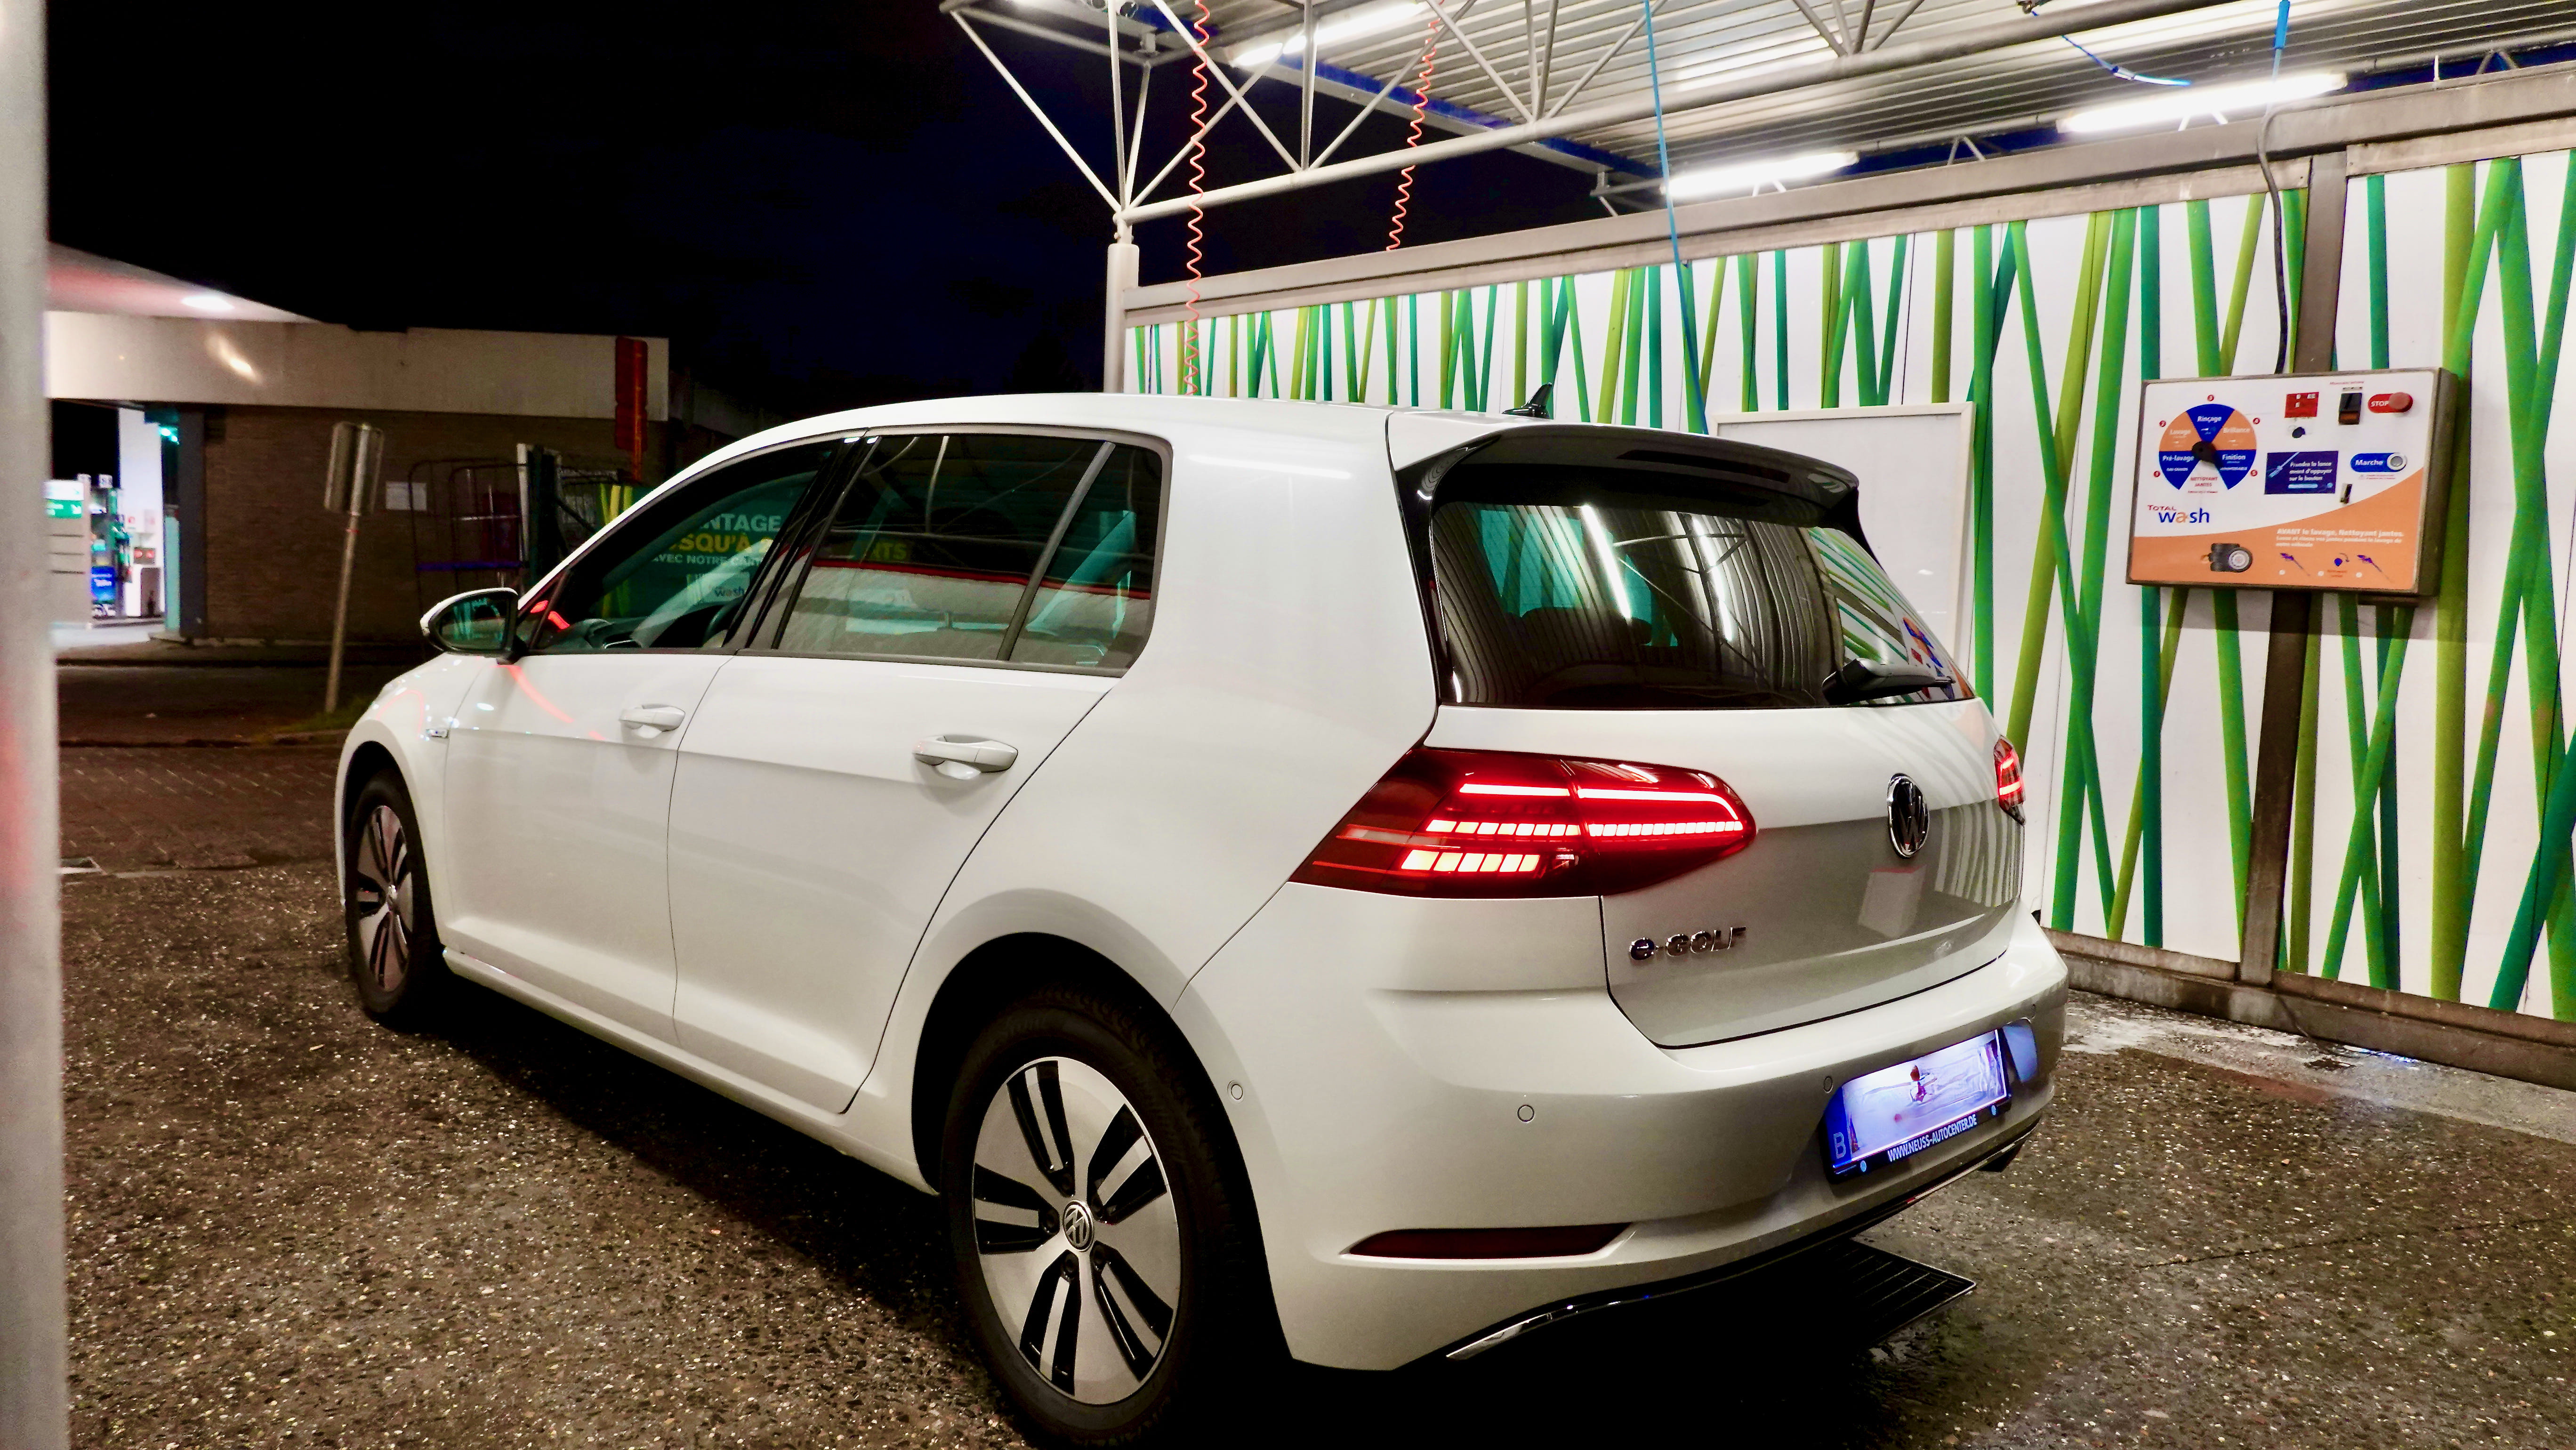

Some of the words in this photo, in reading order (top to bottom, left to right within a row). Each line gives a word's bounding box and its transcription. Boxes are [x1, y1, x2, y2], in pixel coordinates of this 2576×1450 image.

[701, 513, 781, 532] NTAGE
[2158, 507, 2210, 523] wash
[686, 555, 727, 564] NOTRE
[1629, 926, 1746, 960] e-GOLF
[1833, 1132, 1846, 1159] B
[1887, 1113, 1977, 1162] WWW.NEUSS-AUTOCENTER.DE
